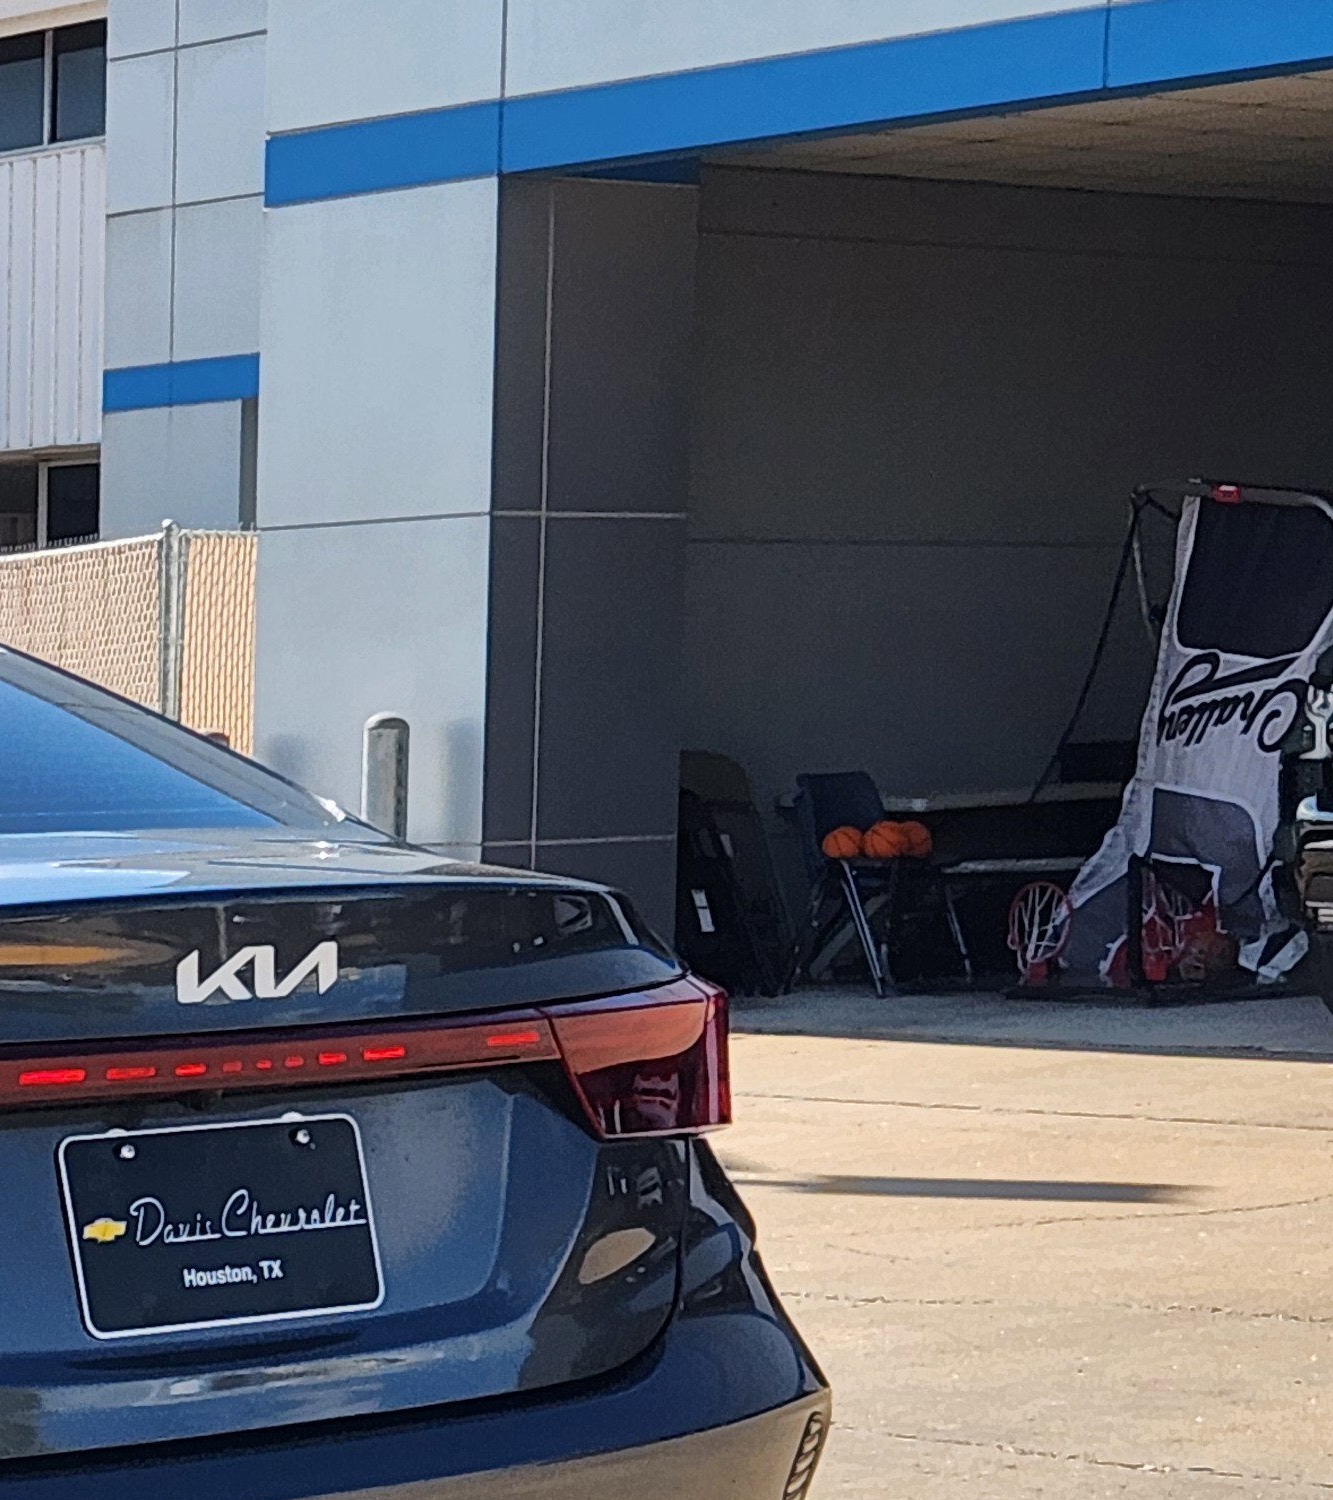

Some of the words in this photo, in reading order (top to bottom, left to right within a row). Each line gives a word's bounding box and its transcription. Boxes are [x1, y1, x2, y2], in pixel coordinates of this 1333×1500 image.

[176, 940, 338, 1004] KIA
[129, 1197, 222, 1246] Davis
[222, 1189, 367, 1237] Chevrolet
[183, 1266, 257, 1288] Houston,
[259, 1260, 284, 1280] TX
